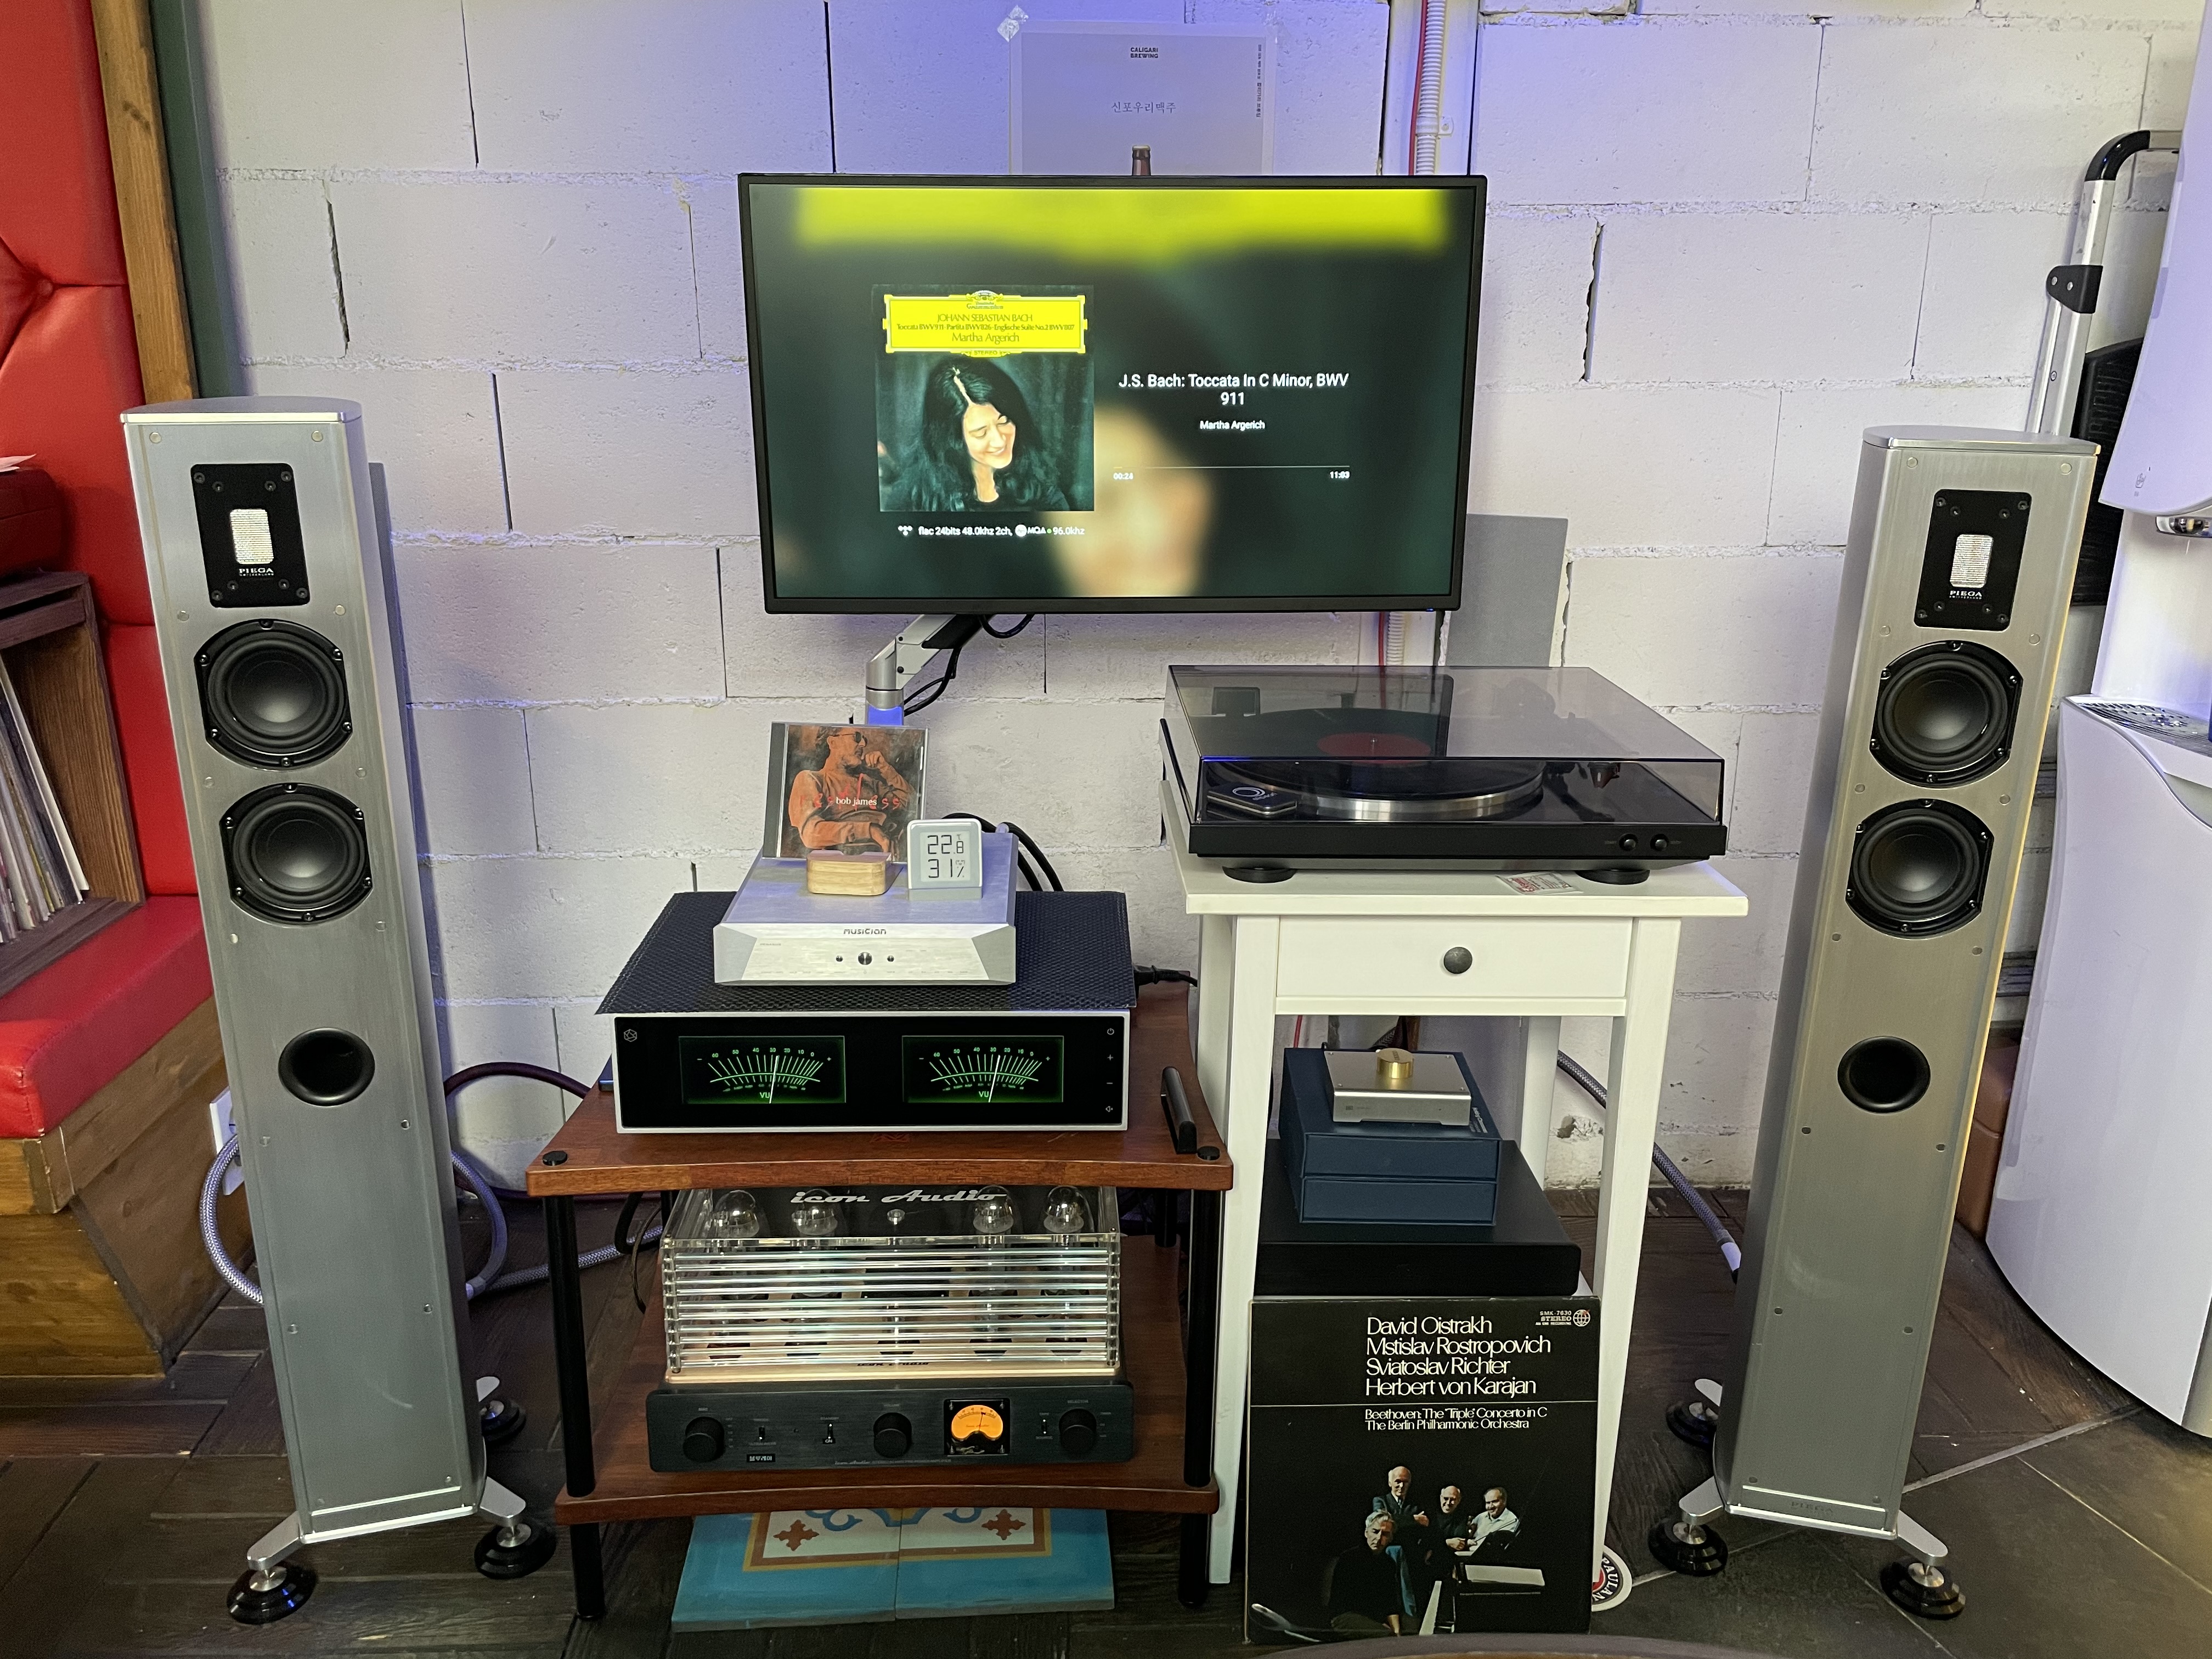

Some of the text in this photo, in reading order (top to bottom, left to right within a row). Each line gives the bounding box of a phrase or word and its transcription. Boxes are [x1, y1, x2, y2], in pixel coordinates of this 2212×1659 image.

[1111, 101, 1176, 114] 신포우리맥주
[937, 314, 970, 323] JOHANN
[972, 314, 1010, 322] SEBASTIAN
[994, 324, 1020, 332] Englische
[952, 332, 1019, 345] Martha Argerich
[1119, 373, 1349, 388] J.S. Bach: Toccata In C Minor, BWV
[1221, 392, 1245, 405] 911
[1200, 420, 1265, 431] Martha Argerich
[918, 526, 934, 535] flac
[935, 526, 961, 535] 24bits
[962, 526, 995, 535] 48.0khz
[1053, 527, 1085, 535] 96.0khz
[852, 798, 877, 806] james
[790, 1189, 1007, 1203] icon Audio
[1367, 1316, 1492, 1334] David Oistrakh
[1367, 1335, 1551, 1358] Mstislav Rostropovich
[1366, 1356, 1511, 1375] Sviatoslav Richter
[1366, 1376, 1536, 1398] Herbert von Karajan
[1365, 1408, 1421, 1420] Beethoven:
[1422, 1408, 1444, 1419] The
[1476, 1407, 1526, 1419] Concerto
[1527, 1407, 1536, 1418] in
[1537, 1406, 1548, 1418] C
[1365, 1418, 1529, 1431] The Berlin Philharmonic Orchestra
